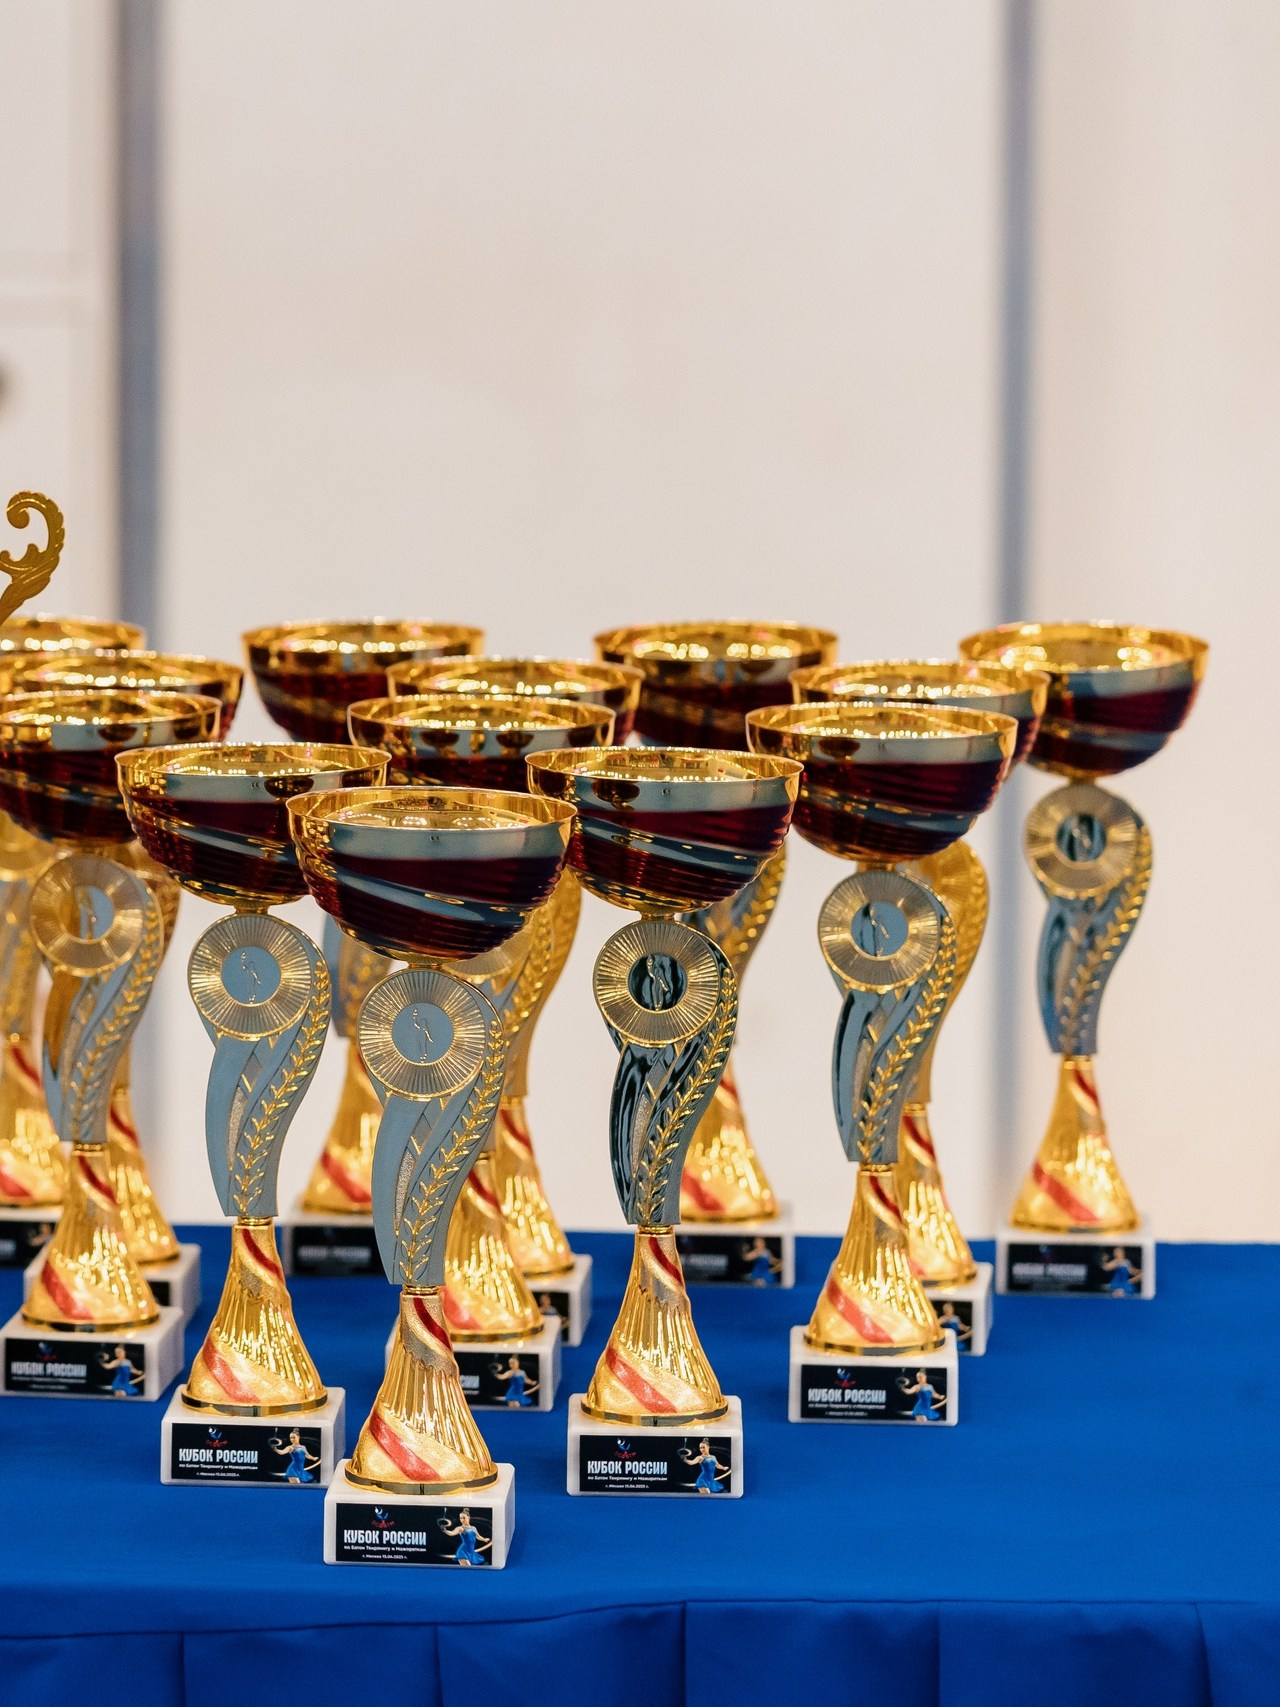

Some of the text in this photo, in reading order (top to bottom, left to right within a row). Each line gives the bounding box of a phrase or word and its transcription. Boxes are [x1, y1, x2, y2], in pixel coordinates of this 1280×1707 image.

[808, 1388, 886, 1403] КУБОК РОССИИ
[179, 1448, 258, 1464] КУБОК РОССИИ
[587, 1460, 667, 1475] КУБОК РОССИИ
[343, 1529, 426, 1545] КУБОК РОССИИ
